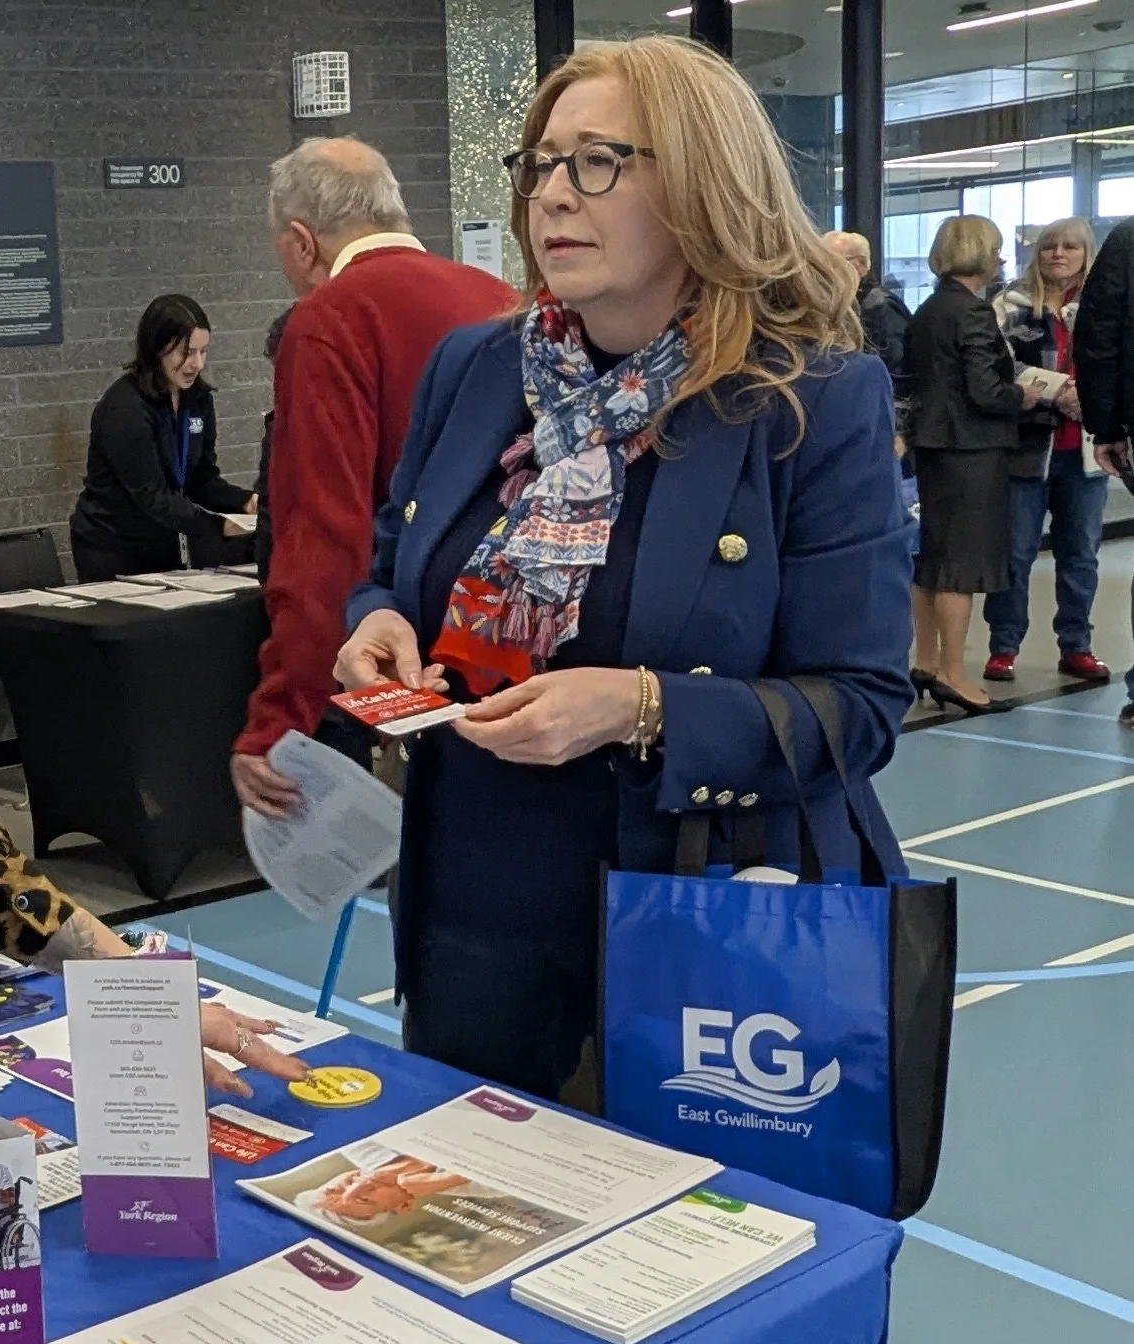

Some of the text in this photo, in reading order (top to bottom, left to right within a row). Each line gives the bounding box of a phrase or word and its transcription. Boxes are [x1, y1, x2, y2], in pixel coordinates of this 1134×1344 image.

[149, 165, 180, 183] 300
[682, 1006, 804, 1091] EG
[678, 1104, 813, 1138] East Gwillimbury
[119, 1210, 178, 1223] York Region
[422, 1203, 526, 1245] CLIENT INTERVENTION
[452, 1198, 546, 1235] SUPPORT SERVICES
[0, 1288, 16, 1299] the
[12, 1303, 28, 1313] the
[8, 1320, 21, 1330] at:
